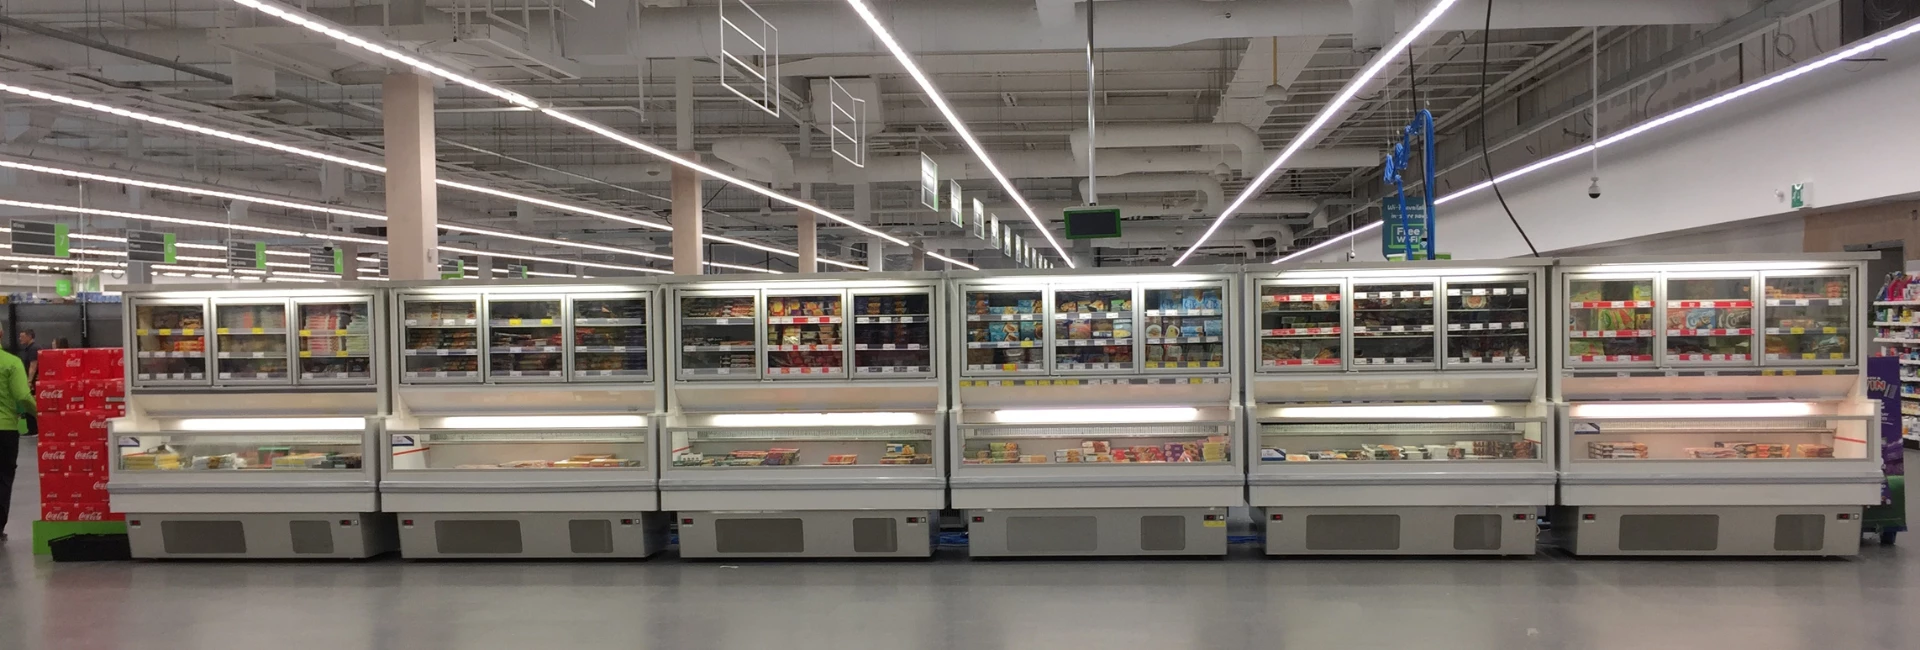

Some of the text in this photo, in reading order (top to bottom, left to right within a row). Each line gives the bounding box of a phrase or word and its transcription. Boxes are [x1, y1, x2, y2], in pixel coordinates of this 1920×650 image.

[60, 235, 64, 246] 7
[40, 389, 64, 399] Coca-Cola
[42, 451, 66, 460] Coca-Cola
[75, 451, 99, 460] Coca-Cola
[46, 512, 69, 520] Coca-Cola
[78, 512, 102, 520] Coca-Cola
